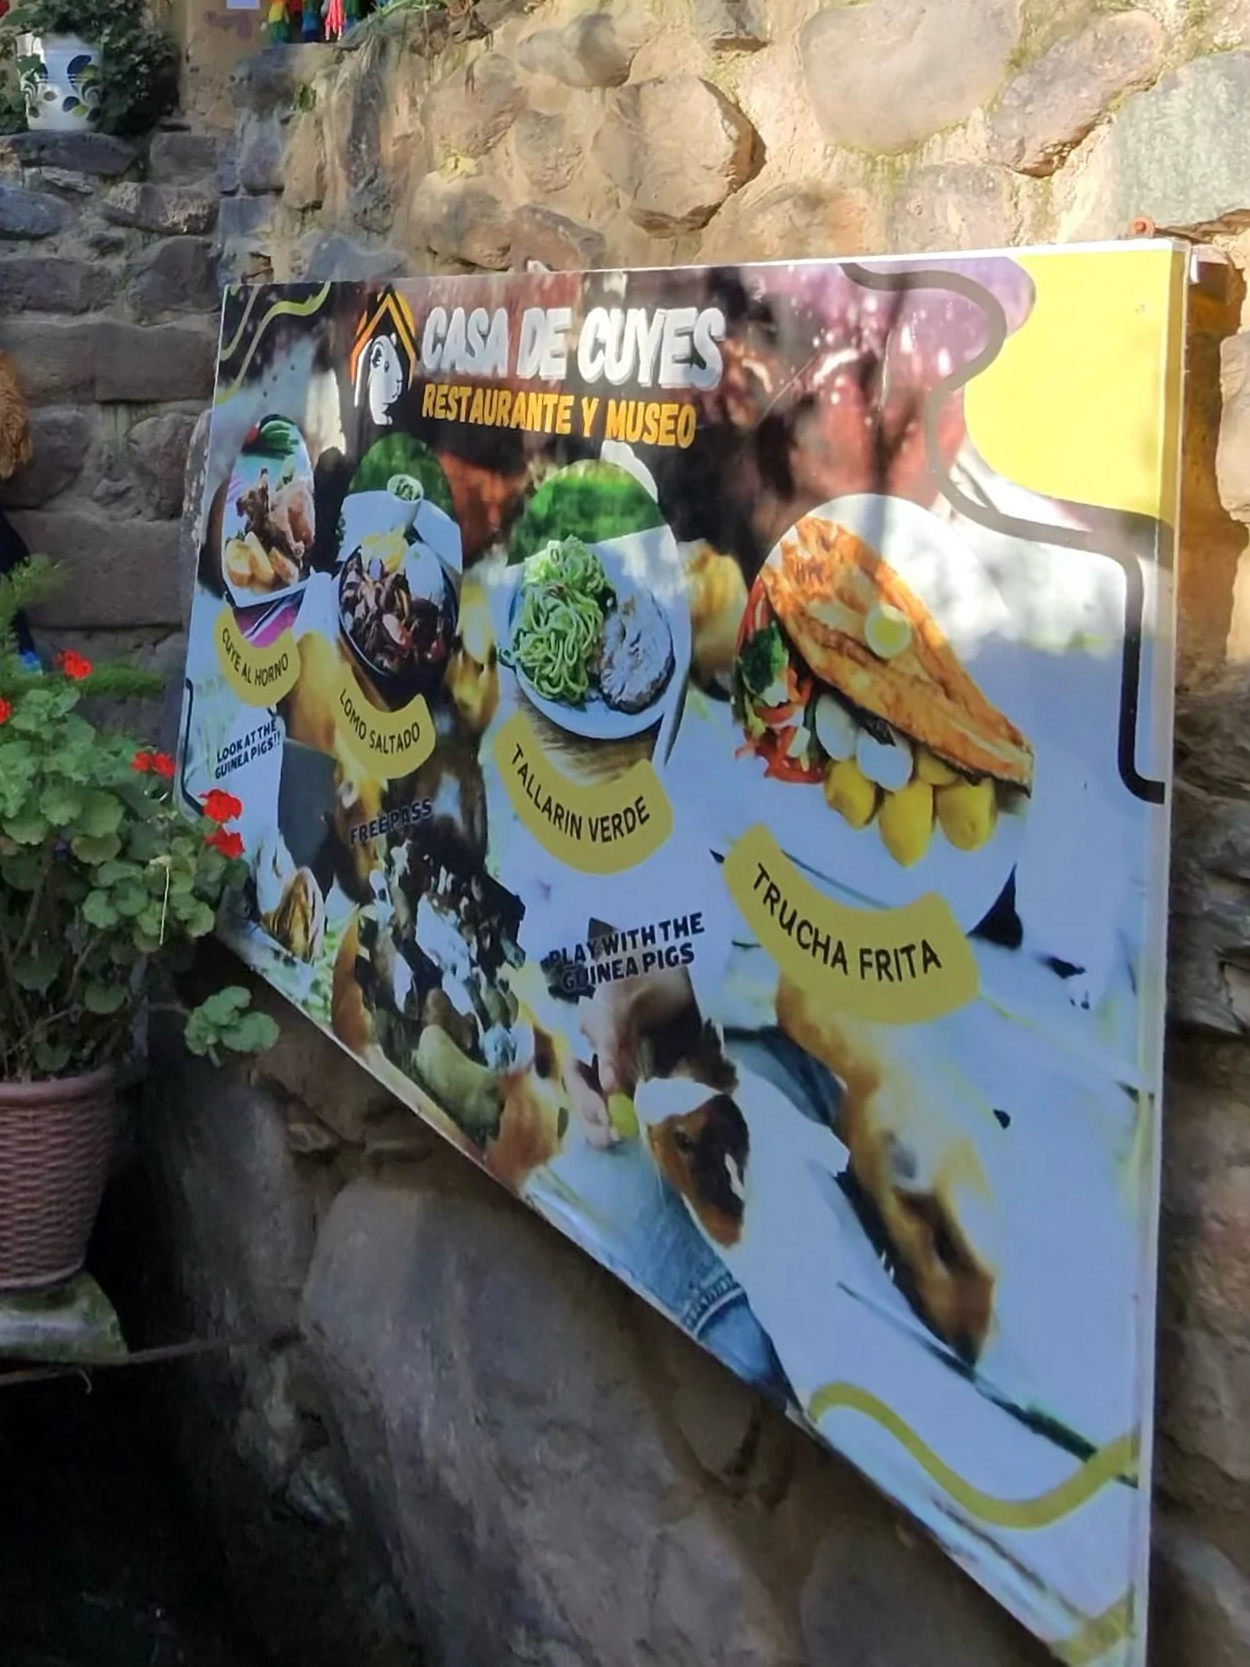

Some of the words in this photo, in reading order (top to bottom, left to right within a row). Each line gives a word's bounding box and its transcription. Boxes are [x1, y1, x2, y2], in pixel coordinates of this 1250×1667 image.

[421, 306, 508, 378] CASA
[516, 306, 573, 381] DE
[577, 306, 726, 392] CUYES
[422, 383, 575, 434] RESTAURANTE
[581, 397, 599, 438] Y
[605, 399, 697, 449] MUSEO
[222, 626, 240, 673] CUYE
[241, 666, 252, 684] AL
[254, 652, 289, 687] HORNO
[217, 738, 243, 763] LOOK
[243, 729, 257, 748] AT
[257, 718, 278, 741] THE
[339, 687, 367, 741] LOMO
[369, 721, 421, 755] SALTADO
[214, 754, 250, 780] GUINEA
[511, 743, 582, 841] TALLARIN
[588, 795, 651, 843] VERDE
[350, 817, 389, 845] FREE
[389, 798, 432, 832] PASS
[549, 943, 601, 969] PLAY
[599, 924, 657, 958] WITH
[659, 912, 705, 943] THE
[753, 862, 849, 976] TRUCHA
[859, 939, 942, 982] FRITA
[562, 955, 640, 991] GUINEA
[641, 942, 695, 975] PIGS
